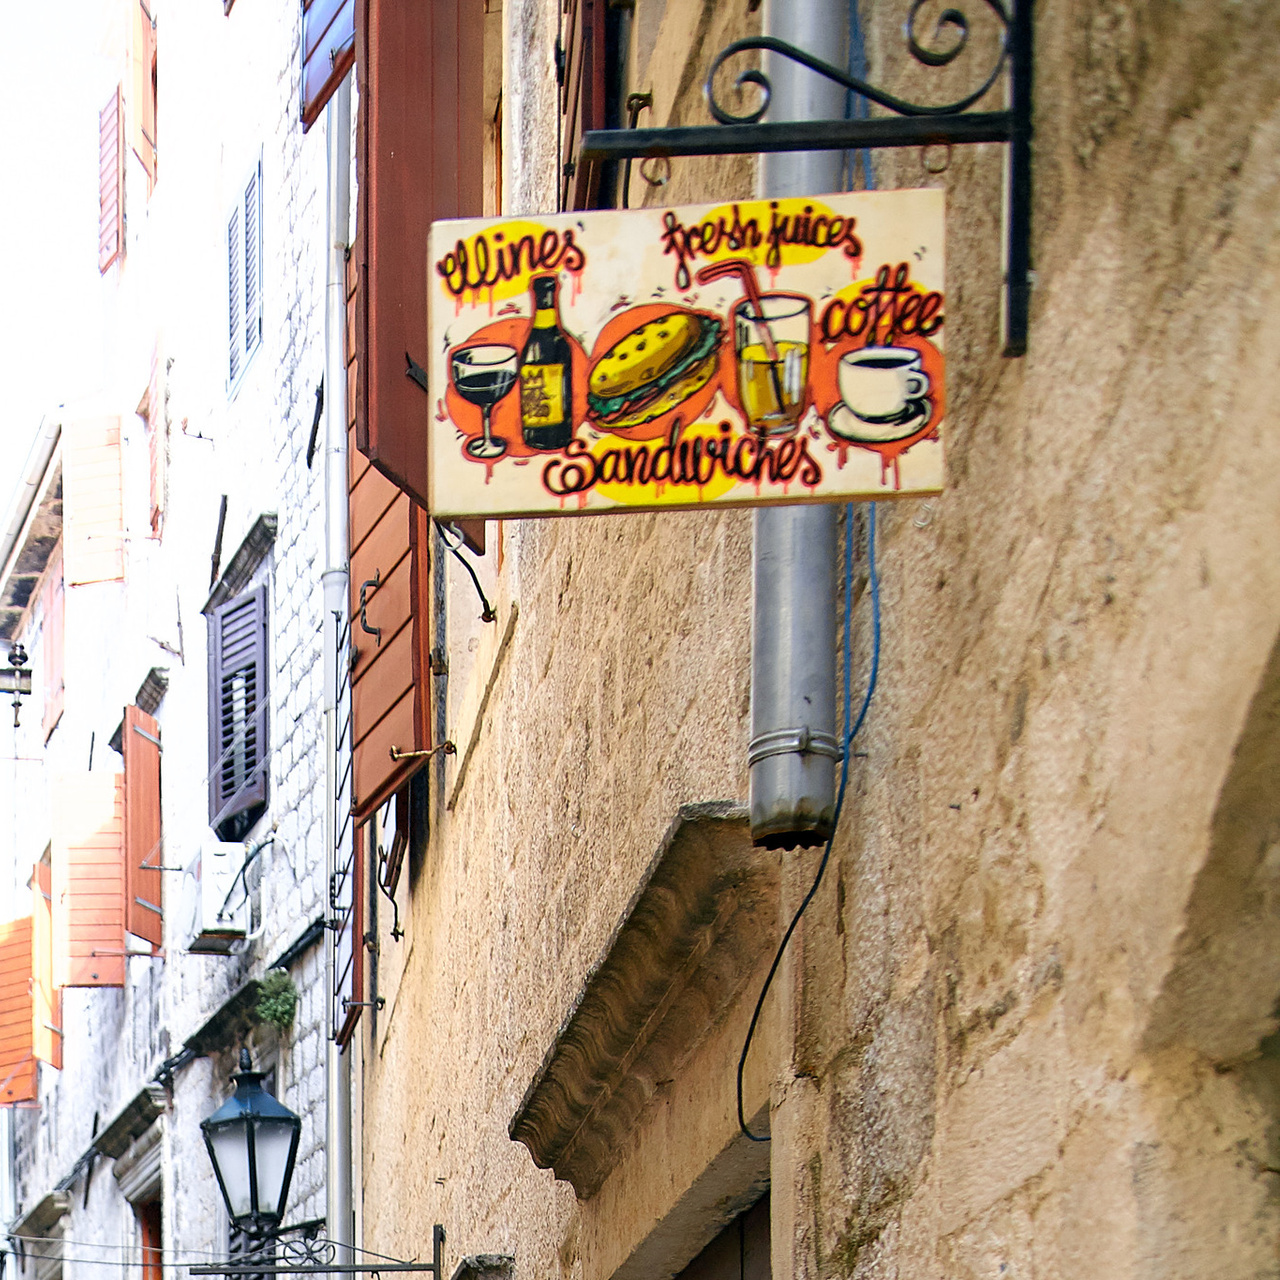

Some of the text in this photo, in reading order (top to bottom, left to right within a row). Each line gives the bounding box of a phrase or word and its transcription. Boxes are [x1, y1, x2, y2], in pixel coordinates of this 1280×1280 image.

[436, 229, 586, 296] Wines
[660, 201, 863, 291] fresh juices
[820, 261, 945, 345] coffee
[542, 418, 824, 495] Sandwiches
